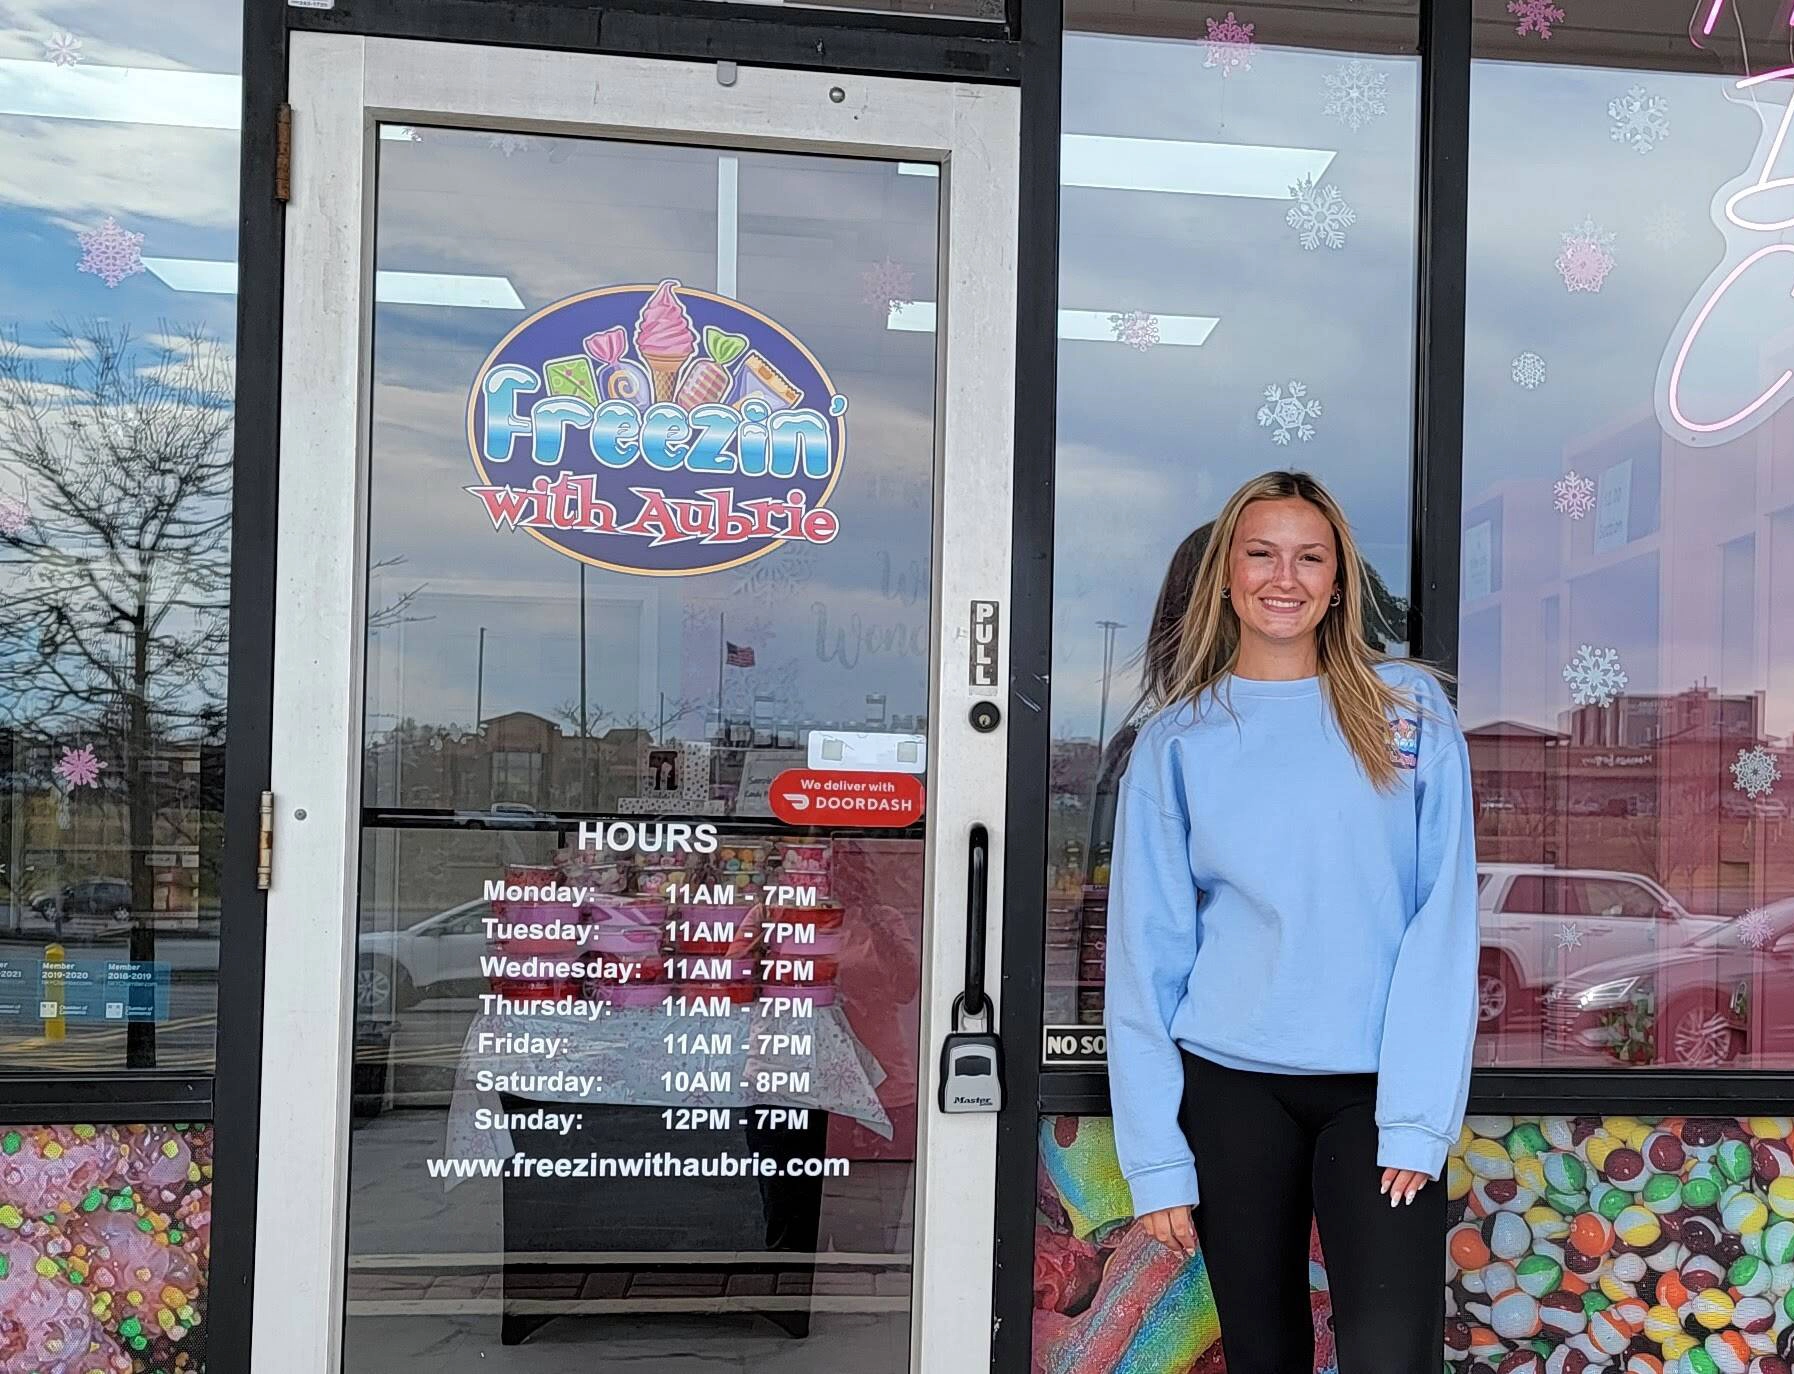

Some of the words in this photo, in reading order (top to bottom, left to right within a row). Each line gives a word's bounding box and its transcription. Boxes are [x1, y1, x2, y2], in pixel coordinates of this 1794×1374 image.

[484, 364, 848, 479] Freezin'
[464, 471, 621, 534] with
[617, 486, 840, 547] Aubrie
[975, 603, 994, 685] PULL
[800, 779, 821, 790] We
[824, 780, 865, 791] deliver
[868, 782, 895, 792] with
[815, 797, 912, 811] DOORDASH
[577, 821, 719, 854] HOURS
[483, 880, 595, 903] Monday:
[665, 885, 734, 905] 11AM
[762, 886, 816, 906] 7PM
[482, 919, 599, 942] Tuesday:
[665, 922, 734, 942] 11AM
[761, 923, 815, 944] 7PM
[42, 971, 89, 979] 2019-2020
[107, 972, 152, 980] 2018-2019
[480, 956, 641, 982] Wednesday:
[663, 960, 732, 979] 11AM
[760, 960, 814, 981] 7PM
[479, 995, 612, 1020] Thursday:
[662, 996, 731, 1017] 11AM
[759, 997, 812, 1018] 7PM
[478, 1033, 568, 1059] Friday:
[664, 1034, 732, 1054] 11AM
[757, 1035, 811, 1055] 7PM
[1047, 1036, 1077, 1055] NO
[476, 1070, 602, 1097] Saturday:
[660, 1072, 731, 1092] 10AM
[756, 1072, 810, 1092] 8PM
[953, 1096, 992, 1105] Master
[475, 1109, 582, 1135] Sunday:
[662, 1109, 730, 1130] 12PM
[755, 1109, 808, 1130] 7PM
[427, 1153, 851, 1177] www.freezinwithaubrie.com
